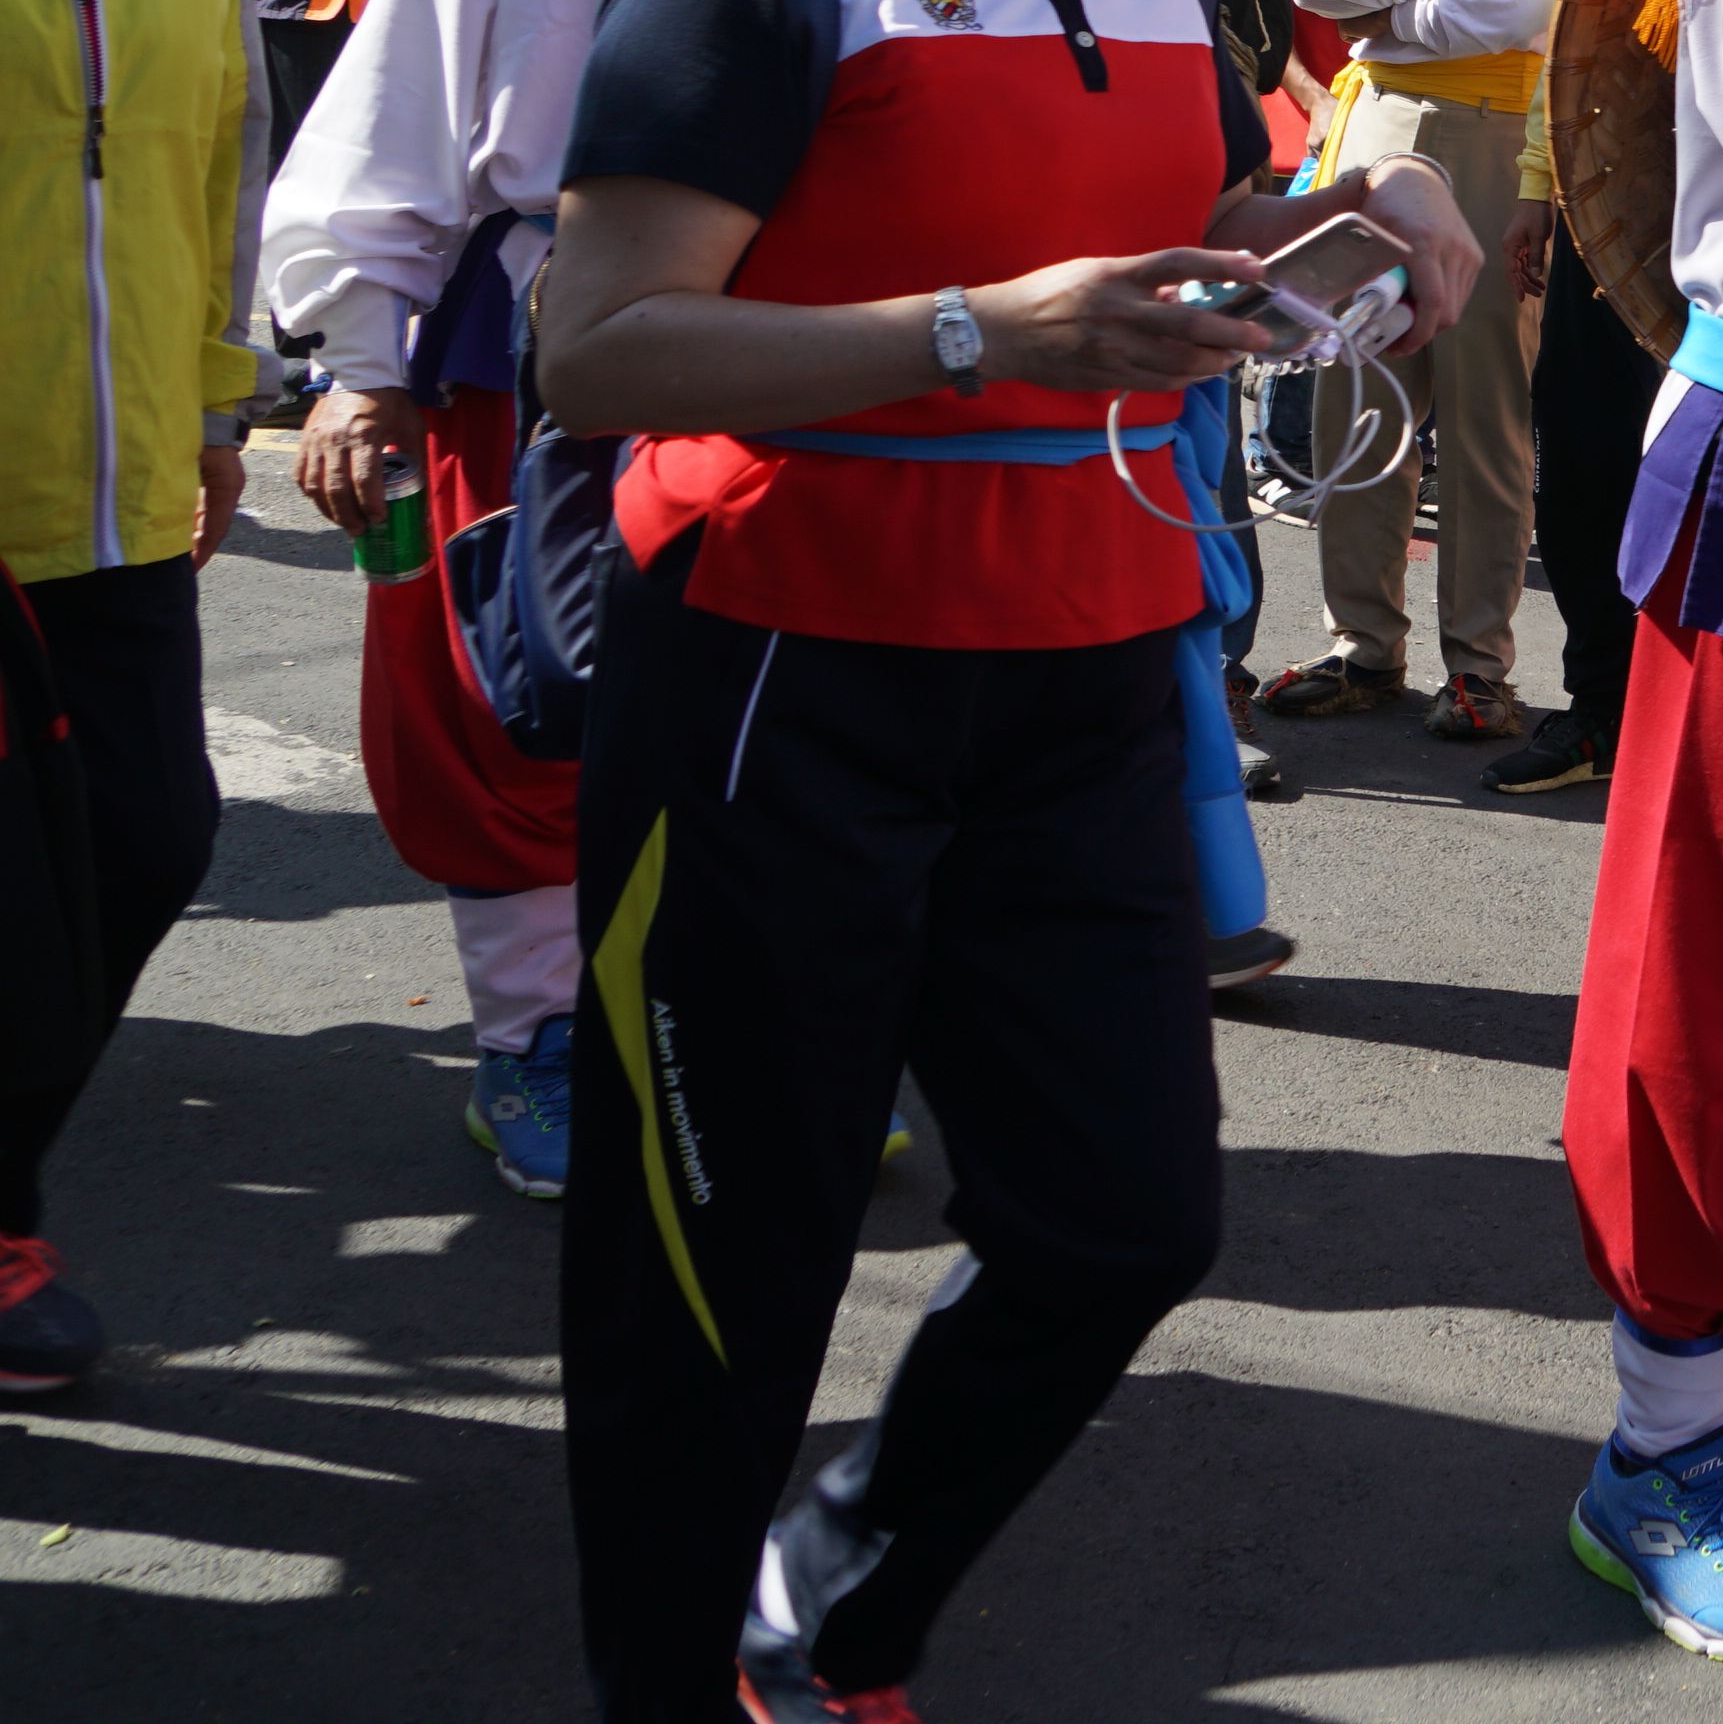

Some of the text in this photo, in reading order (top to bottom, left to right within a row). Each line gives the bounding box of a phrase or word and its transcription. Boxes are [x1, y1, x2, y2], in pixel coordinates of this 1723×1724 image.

[651, 998, 714, 1206] Aiken in movimento
